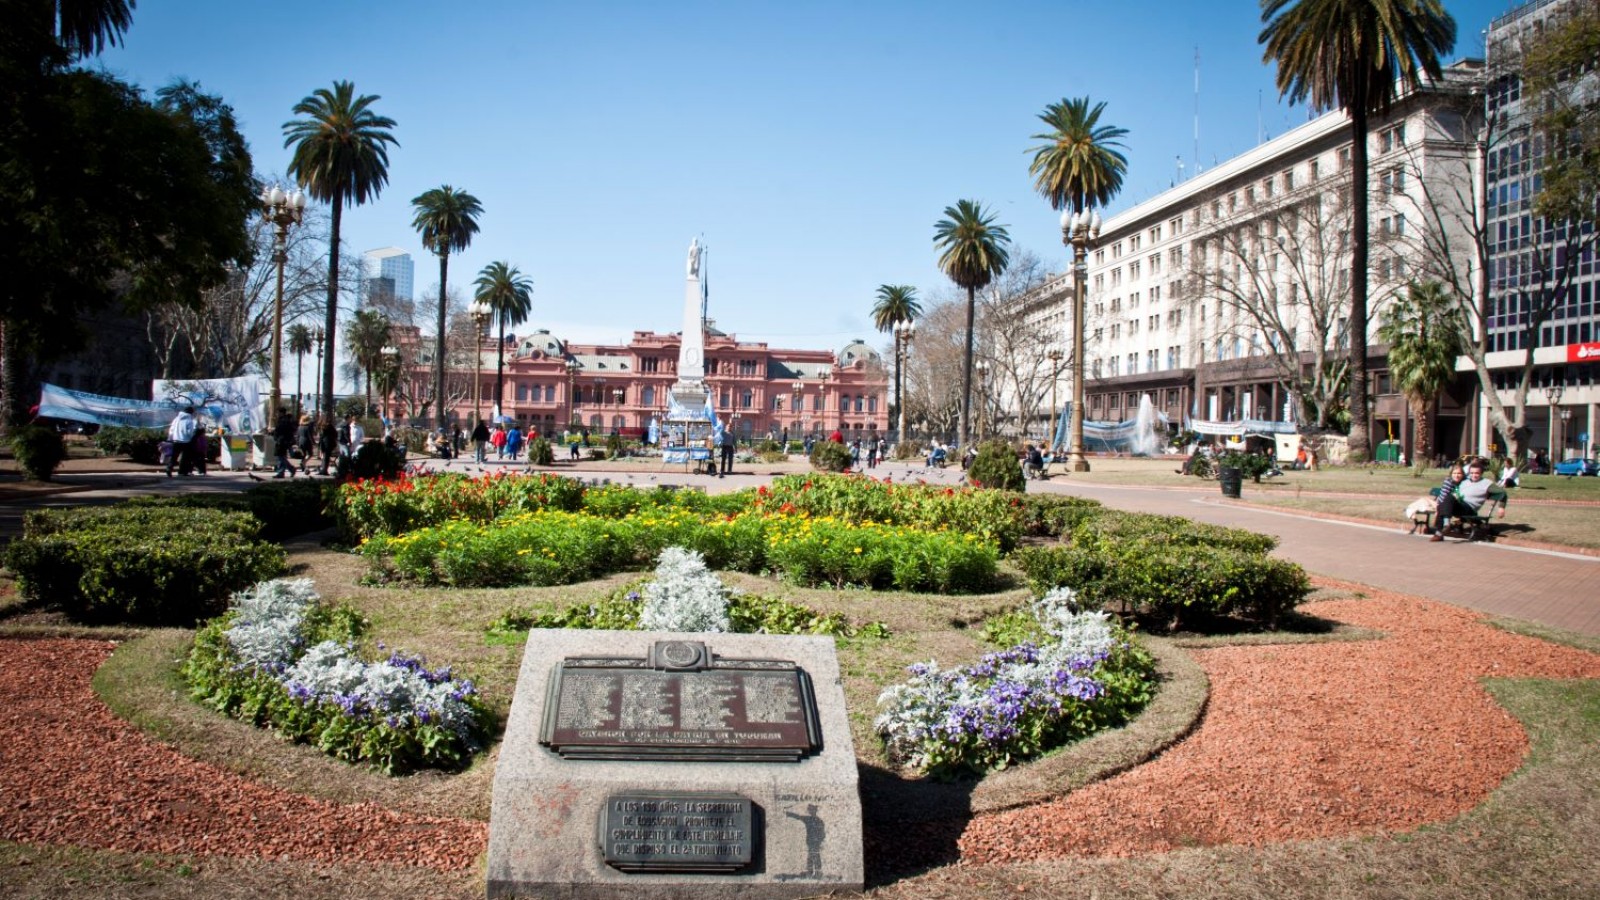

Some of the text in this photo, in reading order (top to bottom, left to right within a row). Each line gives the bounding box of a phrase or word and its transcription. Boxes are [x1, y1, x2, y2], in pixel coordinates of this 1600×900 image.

[615, 801, 622, 812] A
[624, 801, 639, 812] LOS
[685, 801, 697, 812] LA
[622, 815, 633, 826] DE
[614, 843, 630, 855] QUE
[669, 843, 680, 855] EL
